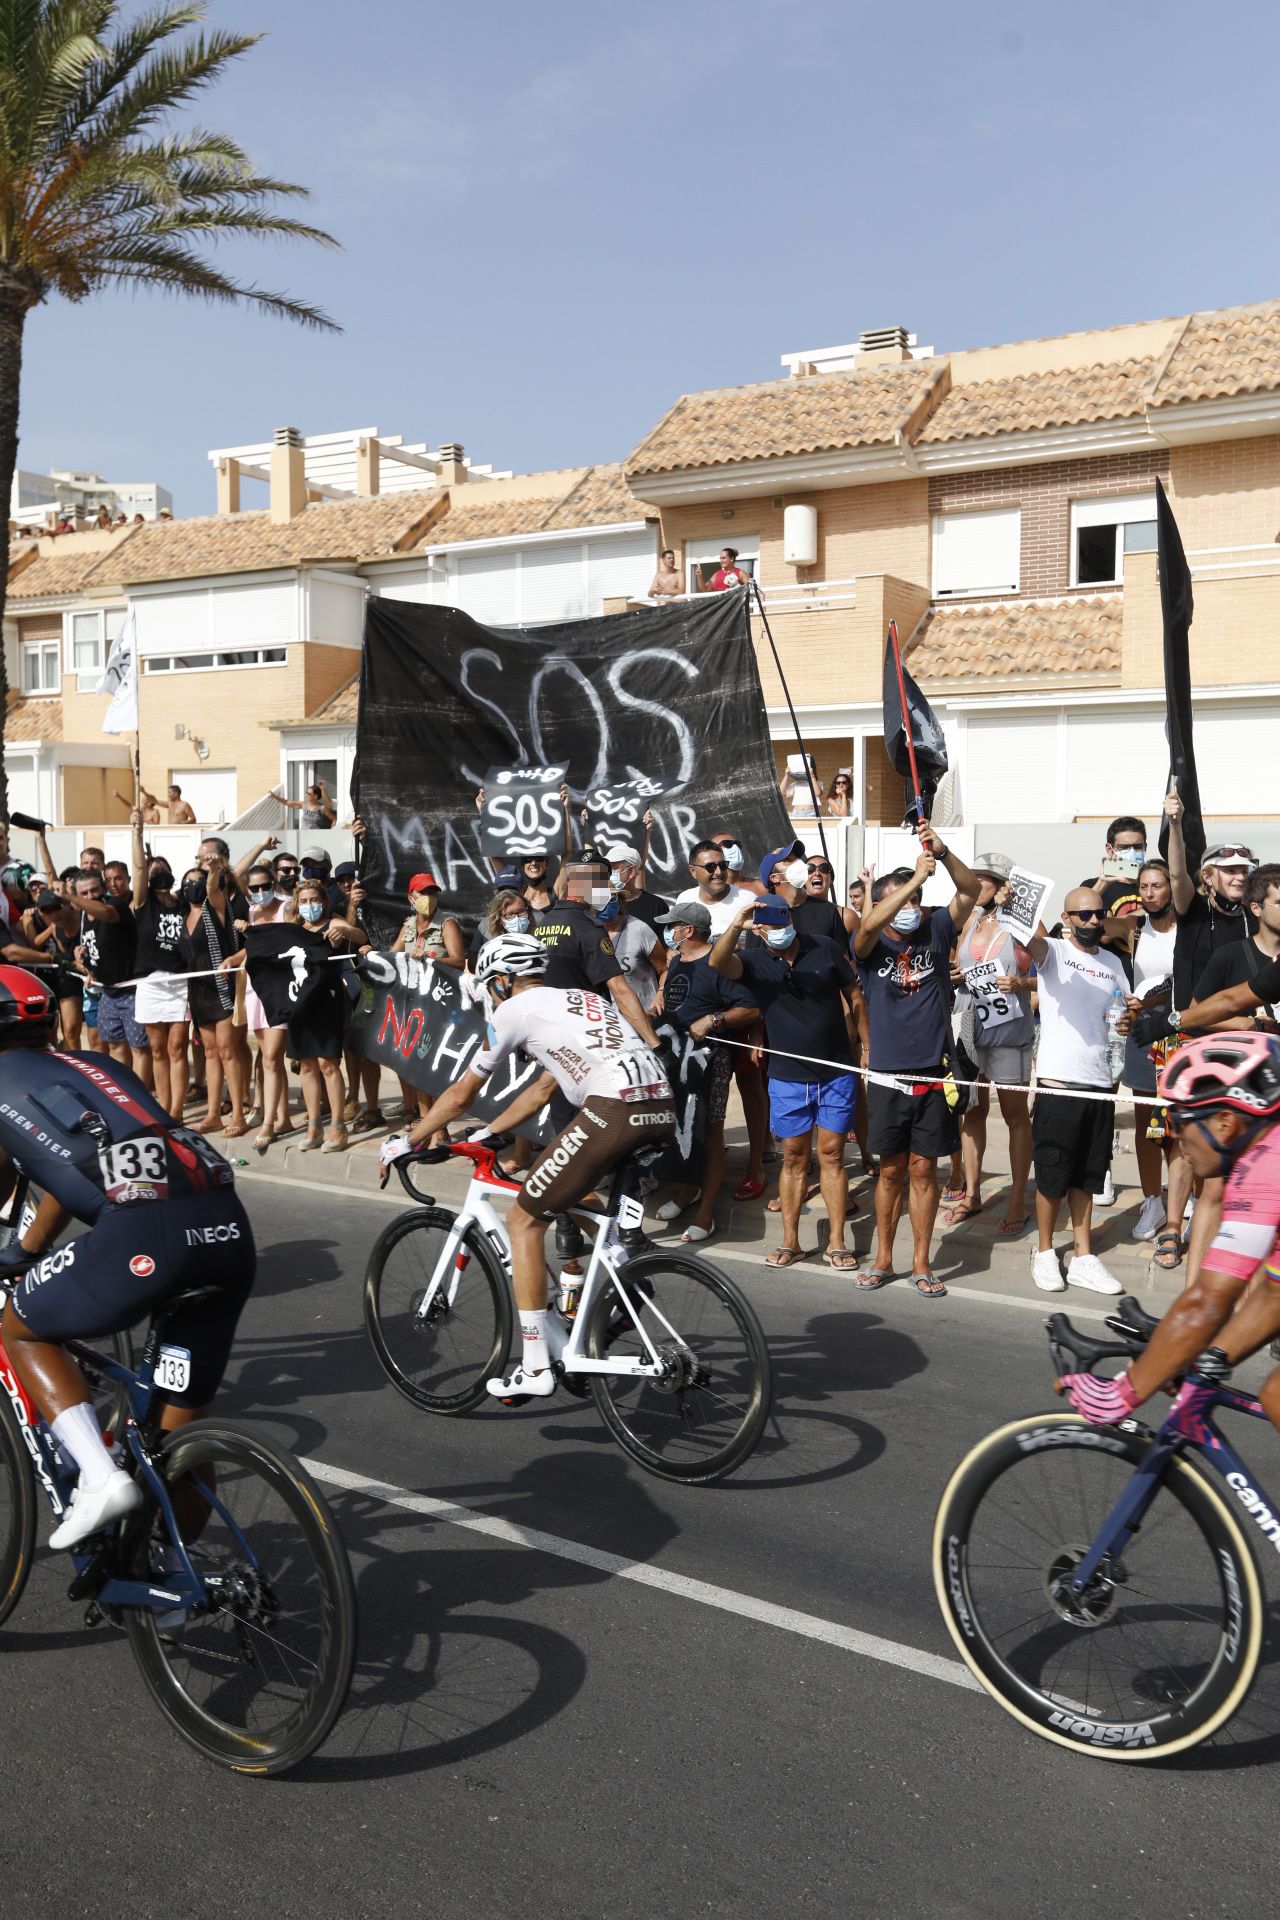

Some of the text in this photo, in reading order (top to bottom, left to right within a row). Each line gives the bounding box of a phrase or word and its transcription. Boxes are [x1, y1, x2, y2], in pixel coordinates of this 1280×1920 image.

[459, 646, 699, 804] SOS
[487, 792, 562, 837] SOS
[586, 789, 641, 822] SOS
[534, 925, 571, 937] GUARDIA
[541, 936, 558, 946] CIVIL
[366, 951, 436, 996] SIN
[377, 994, 425, 1060] NO
[585, 1028, 603, 1050] LA
[546, 1048, 585, 1086] MONDIALE
[558, 1045, 582, 1066] AG2R
[579, 1060, 592, 1077] LA
[617, 1056, 642, 1086] 11
[1226, 1087, 1268, 1110] POC
[0, 1103, 72, 1159] GRENADIER
[103, 1143, 168, 1184] 133
[525, 1125, 590, 1198] CITROËN
[625, 1204, 640, 1220] 11
[184, 1222, 241, 1246] INEOS
[25, 1241, 76, 1295] INEOS
[160, 1358, 185, 1389] 133
[1226, 1472, 1280, 1554] cann
[1218, 1547, 1245, 1663] metron
[1047, 1711, 1157, 1748] Vision
